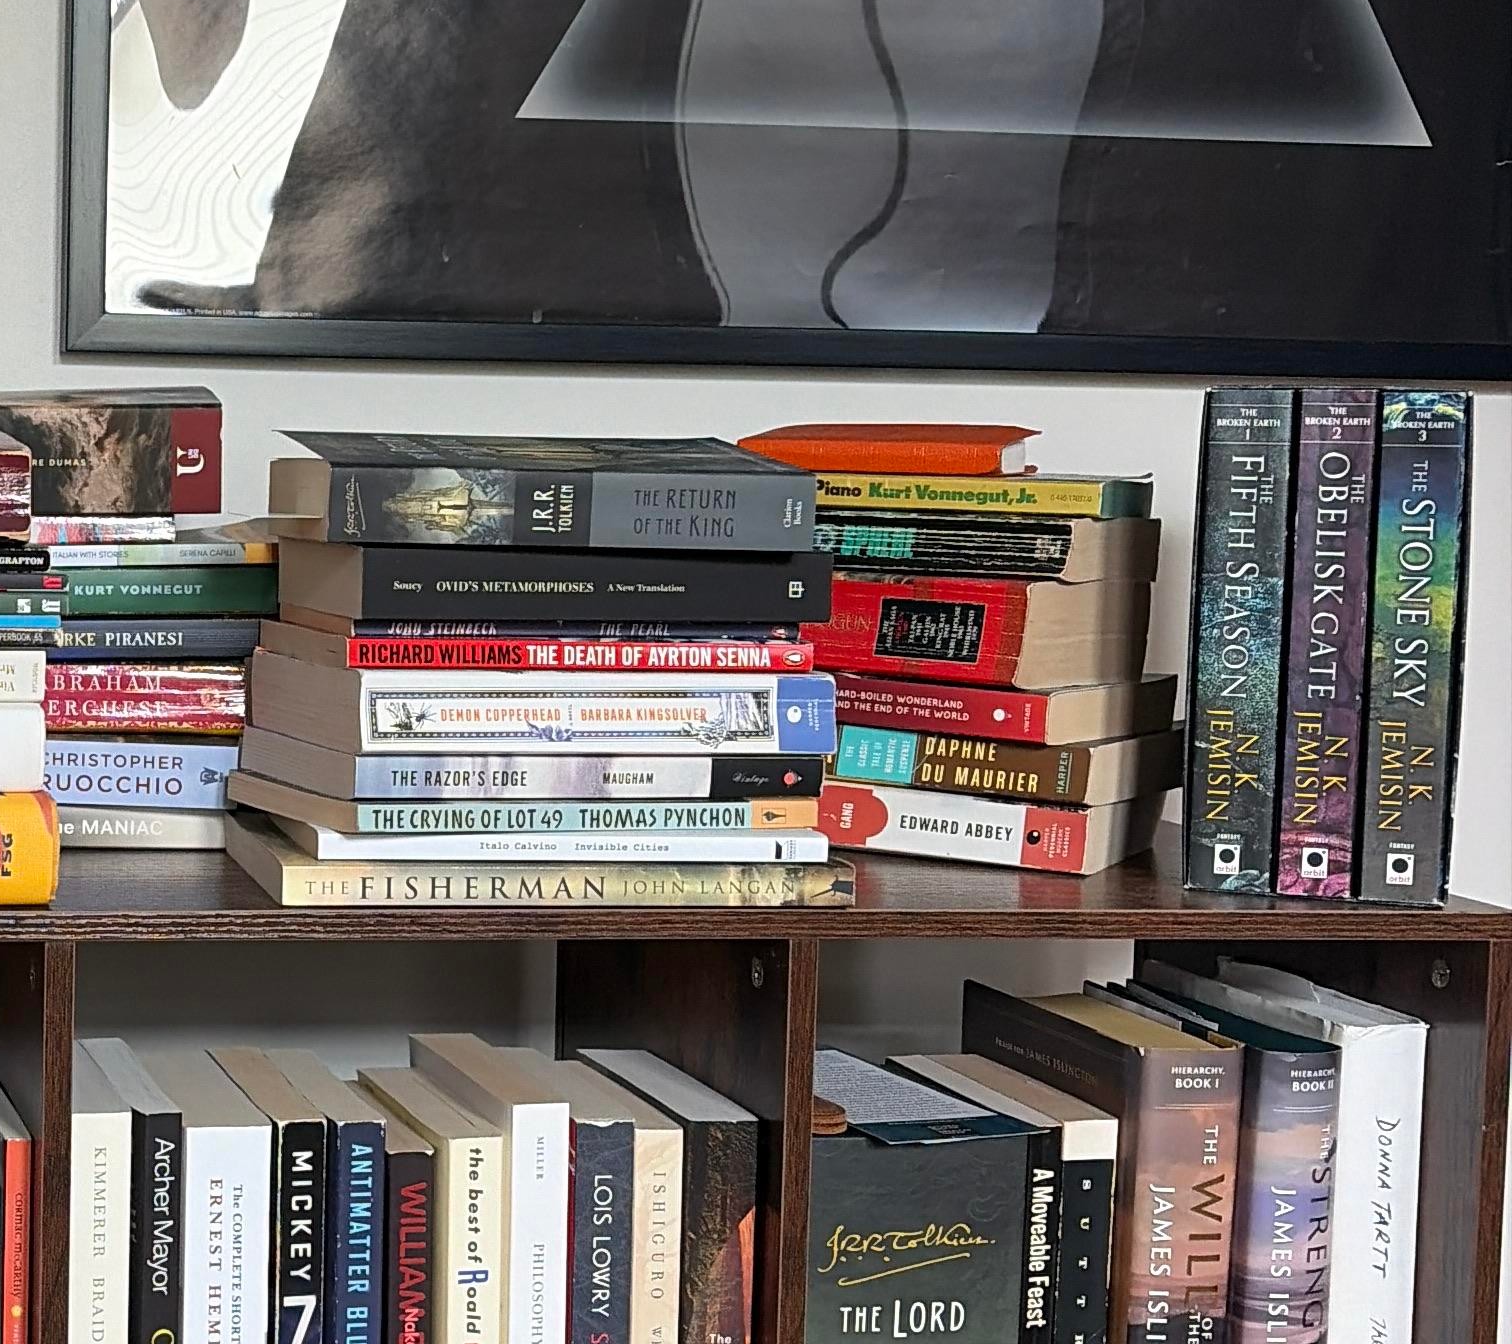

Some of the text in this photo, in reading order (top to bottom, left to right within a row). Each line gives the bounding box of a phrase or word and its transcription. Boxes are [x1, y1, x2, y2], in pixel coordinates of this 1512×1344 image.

[634, 487, 736, 510] THE RETURN
[868, 482, 1037, 505] Kurt Vonnegut, Jr.
[634, 514, 734, 538] OF THE KING
[74, 583, 203, 596] KURT VONNEGUT
[393, 580, 594, 594] Soucy OVID'S METAMORPHOSES
[1220, 455, 1265, 699] FIFTH SEASON
[1307, 452, 1351, 700] OBELISK GATE
[1392, 499, 1436, 706] STONE SKY
[105, 631, 184, 647] PIRANESI
[359, 642, 771, 667] RICHARD WILLIAMS THE DEATH OF AYRTON SENNA
[925, 736, 997, 762] DAPHNE
[921, 763, 1039, 794] DU MAURIER
[1293, 710, 1322, 825] JEMISIN
[900, 815, 1014, 841] EDWARD ABBEY
[304, 875, 796, 900] THE FISHERMAN JOHN LANGAN
[152, 1137, 176, 1216] Archer
[1370, 1116, 1400, 1279] DONNA TARTT
[290, 1150, 314, 1282] MICKEY
[347, 1144, 374, 1294] ANTIMATTER
[146, 1220, 174, 1296] Mayor
[1026, 1168, 1055, 1329] A Moveable Feast
[840, 1300, 967, 1339] THE LORD
[710, 1334, 731, 1344] The
